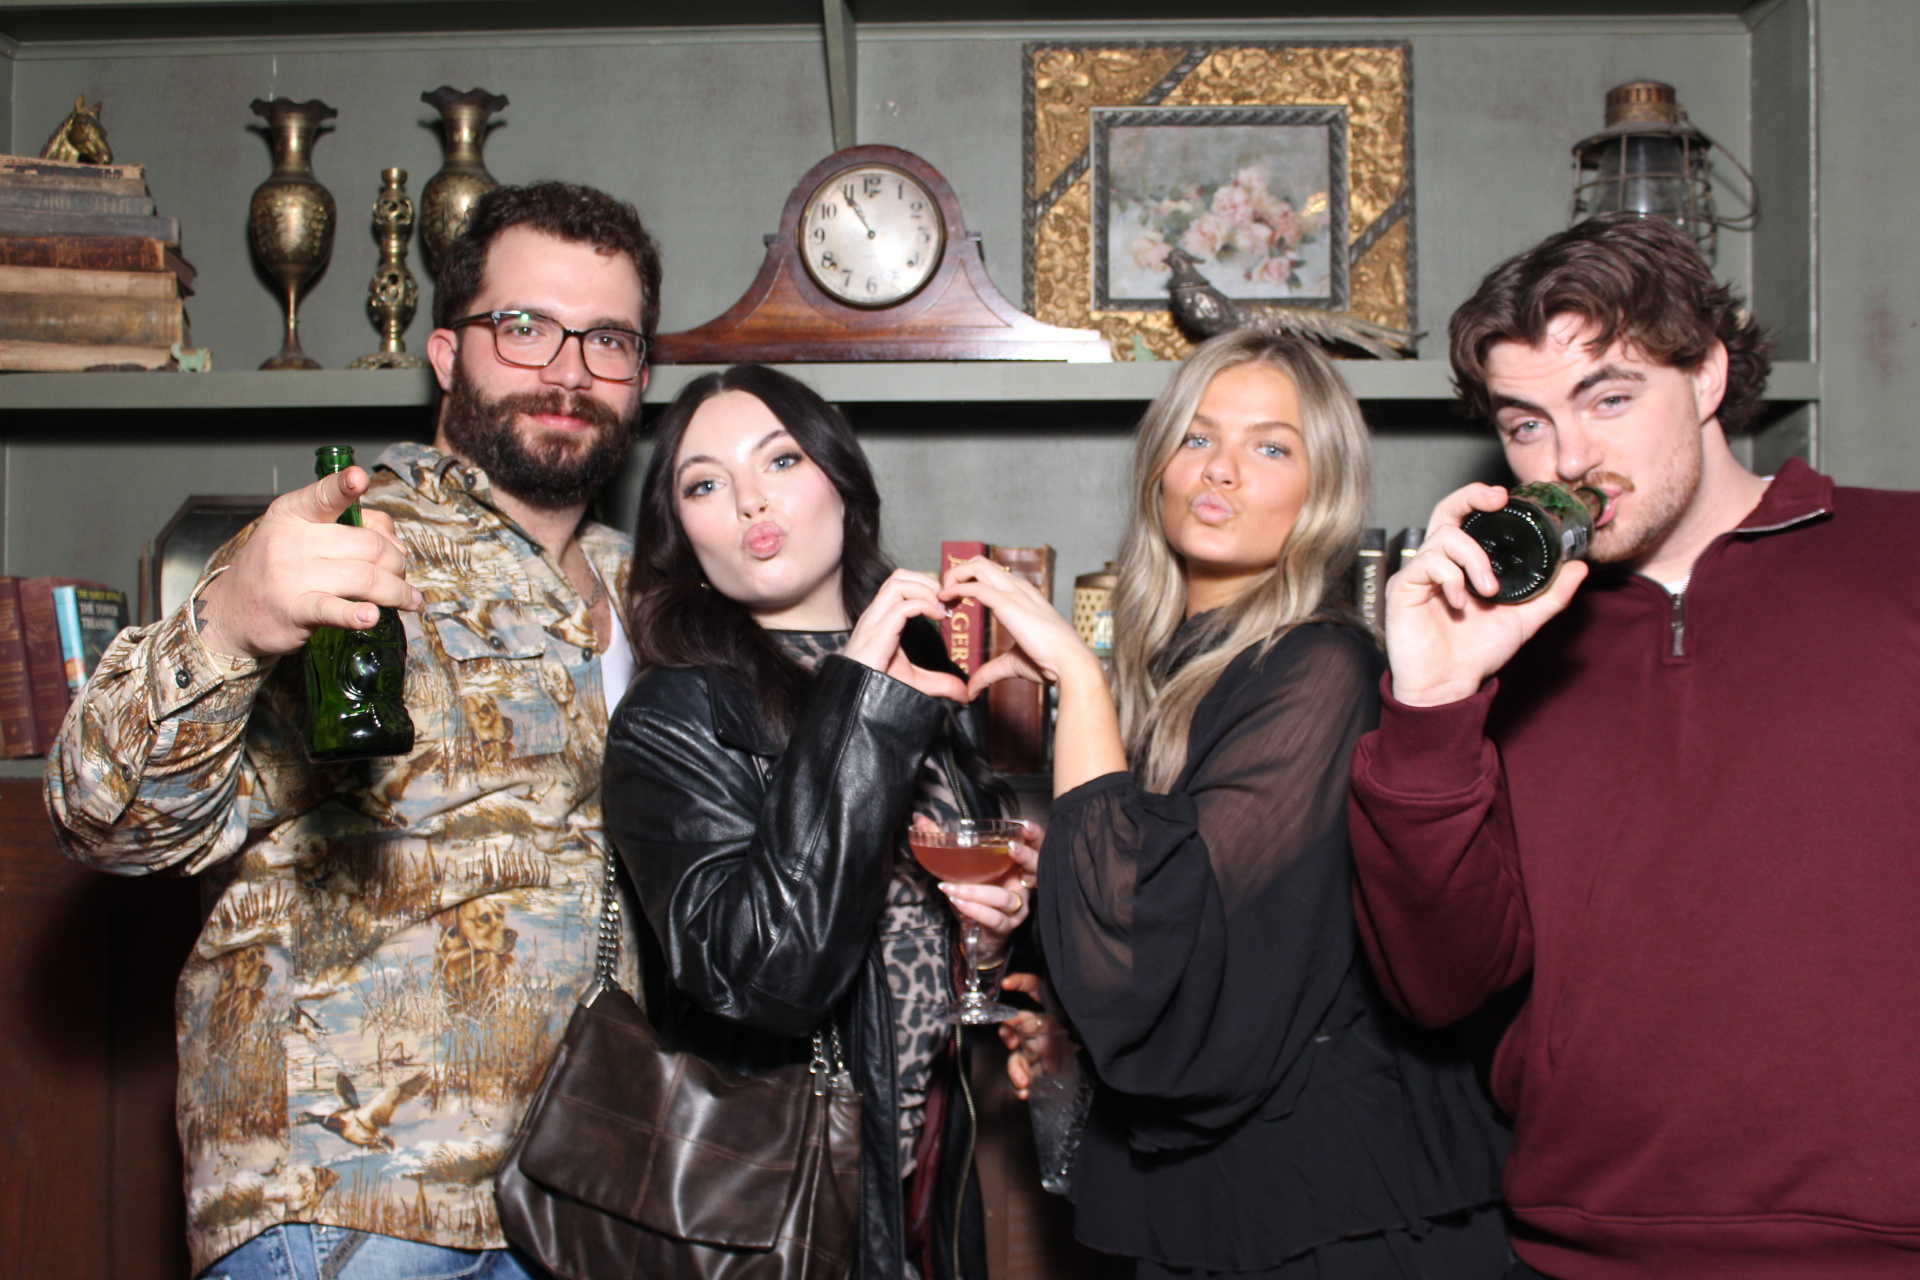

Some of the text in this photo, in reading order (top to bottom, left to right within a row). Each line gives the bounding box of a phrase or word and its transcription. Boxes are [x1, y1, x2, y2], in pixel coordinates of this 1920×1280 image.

[863, 176, 881, 198] 12
[898, 183, 903, 200] 1
[821, 203, 837, 220] 10
[910, 201, 923, 219] 2
[814, 228, 825, 245] 9
[918, 225, 930, 244] 3
[821, 252, 833, 269] 8
[841, 269, 853, 287] 7
[866, 276, 877, 294] 6
